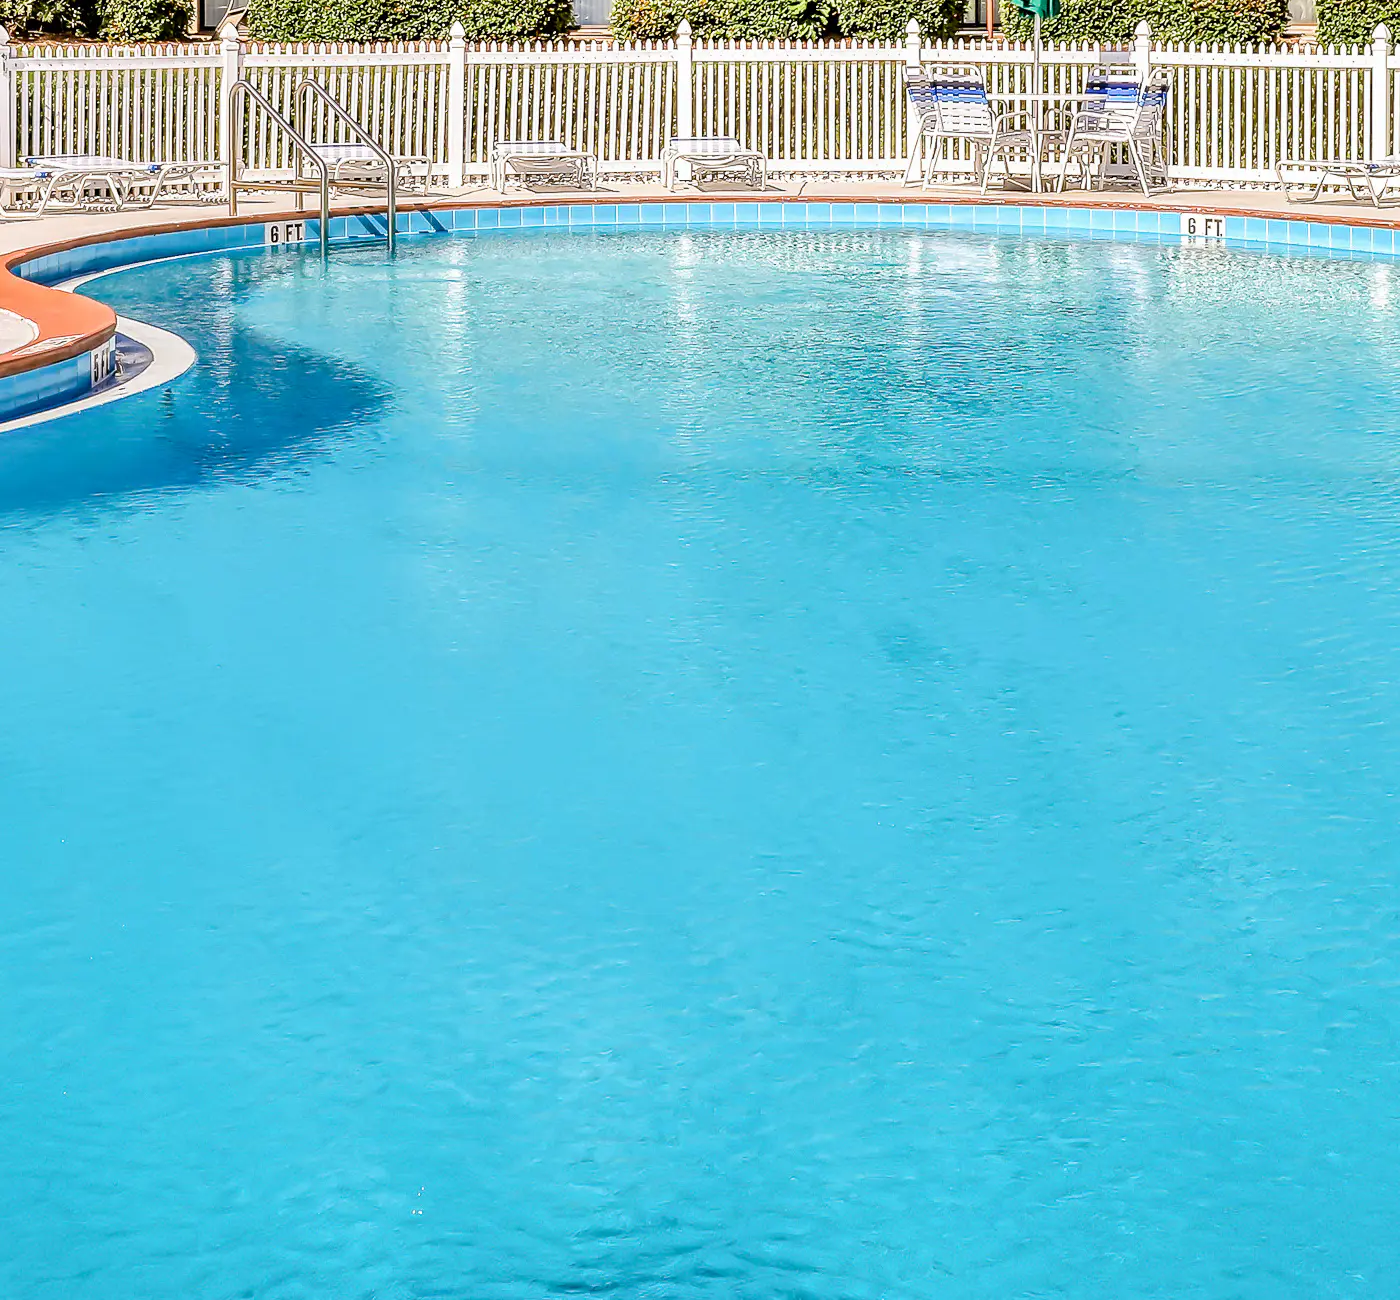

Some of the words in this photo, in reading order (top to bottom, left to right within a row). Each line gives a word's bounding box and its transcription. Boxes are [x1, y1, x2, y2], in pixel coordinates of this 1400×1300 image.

[270, 225, 279, 243] 6
[286, 223, 303, 242] FT.
[1188, 217, 1196, 235] 6
[1205, 218, 1223, 237] FT.
[93, 353, 99, 382] 5
